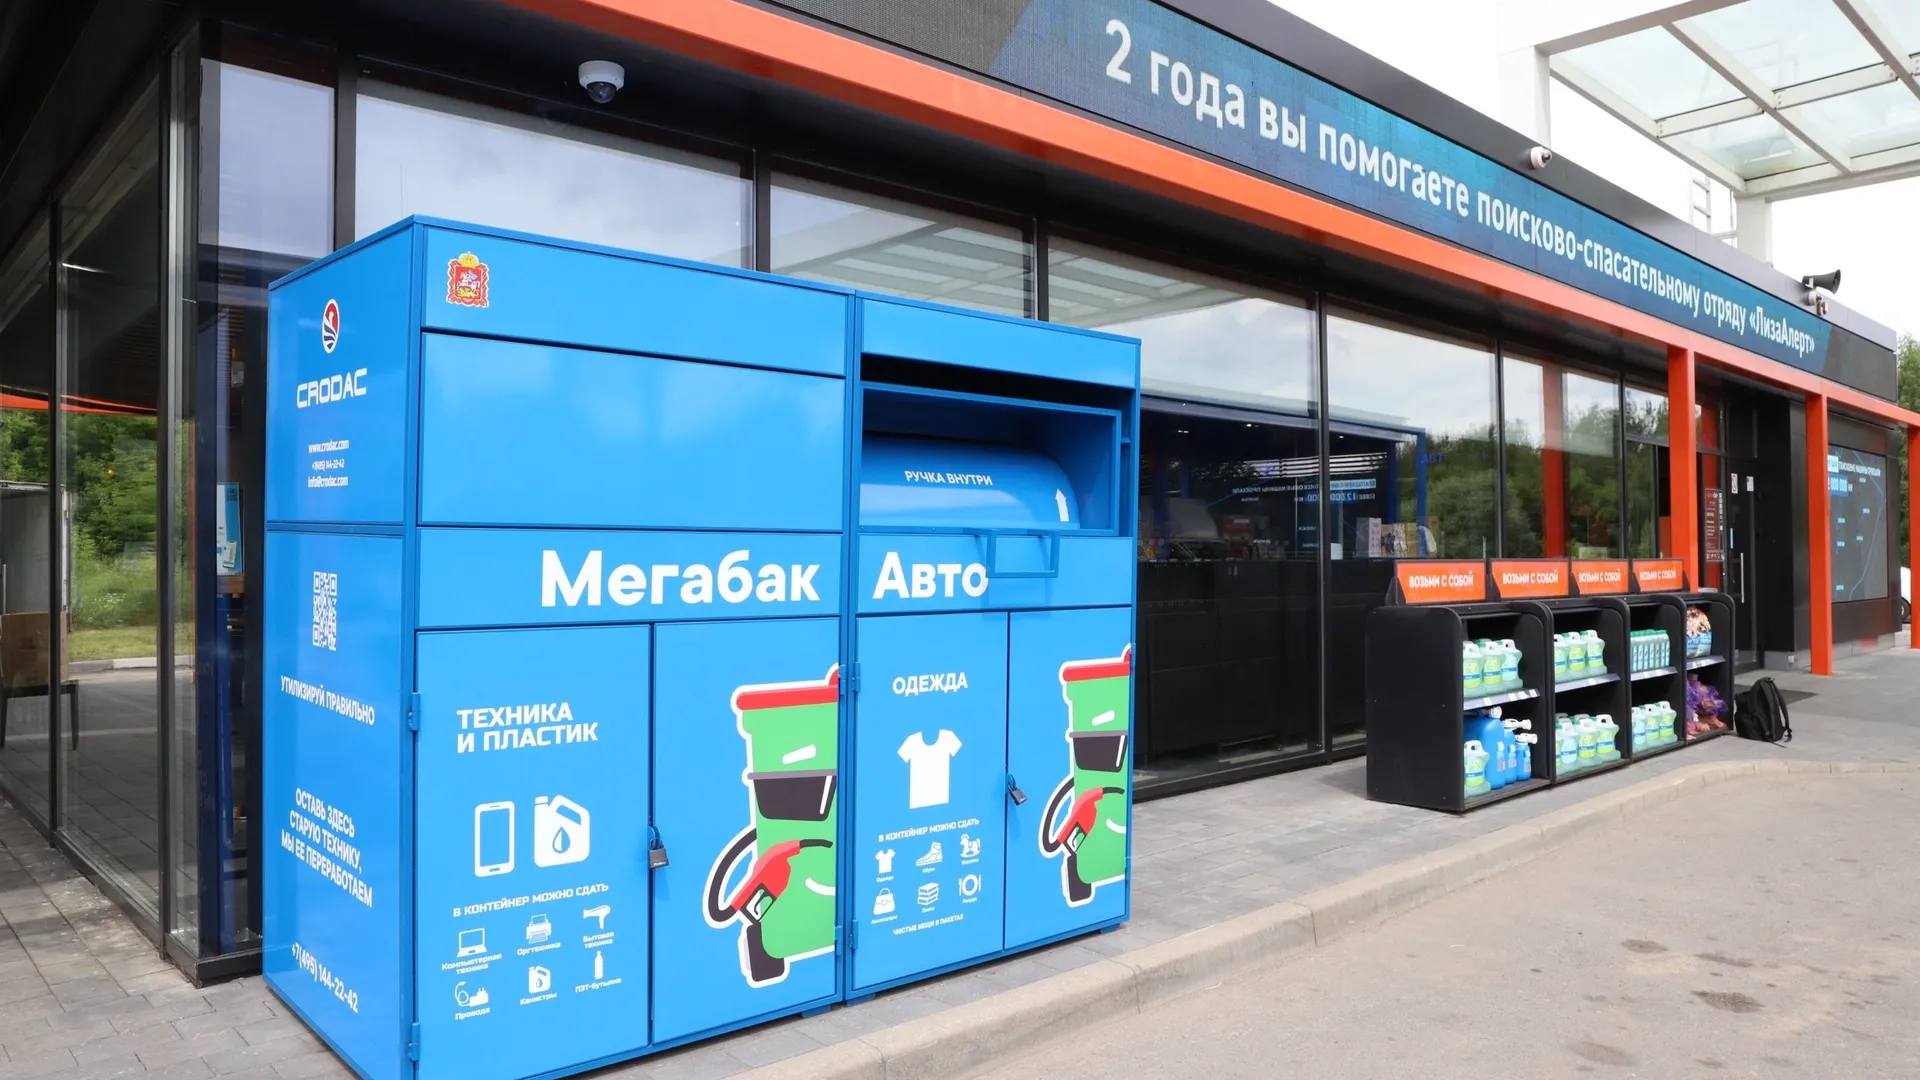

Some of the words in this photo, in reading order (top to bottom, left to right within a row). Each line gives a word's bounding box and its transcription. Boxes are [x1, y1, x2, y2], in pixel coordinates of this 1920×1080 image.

[1105, 19, 1132, 84] 2
[1150, 51, 1246, 129] года
[1259, 97, 1307, 153] вы
[1318, 123, 1470, 218] помогаете
[1477, 190, 1701, 318] поисково-спасательному
[1704, 291, 1747, 335] отряду
[1749, 306, 1816, 358] «ЛизаАлерт»
[296, 367, 368, 409] CRODAC
[904, 470, 946, 484] РУЧКА
[946, 473, 994, 486] ВНУТРИ
[541, 549, 821, 607] Мегабак
[872, 551, 989, 600] Авто
[1409, 575, 1440, 588] ВОЗЬМИ
[1441, 575, 1447, 587] С
[1448, 570, 1474, 587] СОБОЙ
[1502, 572, 1530, 584] ВОЗЬМИ
[1530, 572, 1536, 584] С
[1536, 569, 1559, 584] СОБОЙ
[1579, 572, 1599, 583] ВОЗЬМИ
[1604, 568, 1621, 582] СОБОЙ
[892, 671, 969, 697] ОДЕЖДА
[280, 675, 325, 708] УТИЛИЗИРУЙ
[326, 690, 375, 726] ПРАВИЛЬНО
[456, 702, 574, 730] ТЕХНИКА
[457, 732, 475, 753] И
[483, 722, 599, 752] ПЛАСТИК
[295, 787, 326, 821] ОСТАВЬ
[327, 805, 355, 839] ЗДЕСЬ
[289, 809, 321, 844] СТАРУЮ
[321, 827, 363, 875] ТЕХНИКУ,
[878, 834, 885, 843] В
[885, 827, 929, 841] КОНТЕЙНЕР
[929, 822, 957, 834] МОЖНО
[957, 818, 980, 828] СДАТЬ
[281, 828, 295, 854] МЫ
[295, 837, 305, 861] ЕЕ
[305, 844, 373, 908] ПЕРЕРАБОТАЕМ
[452, 907, 462, 917] В
[464, 895, 530, 917] КОНТЕЙНЕР
[532, 888, 574, 904] МОЖНО
[575, 882, 609, 897] СДАТЬ
[893, 924, 917, 935] ЧИСТЫЕ
[917, 921, 935, 931] ВЕЩИ
[939, 913, 964, 925] ПАКЕТАХ
[516, 941, 561, 956] Оргтехника
[584, 938, 613, 949] техника
[441, 953, 503, 971] Компьютерная
[455, 963, 489, 975] техника
[291, 941, 318, 983] +7(495)
[318, 963, 359, 1014] 144-22-42
[519, 992, 558, 1006] Канистры
[455, 1007, 491, 1021] Провода
